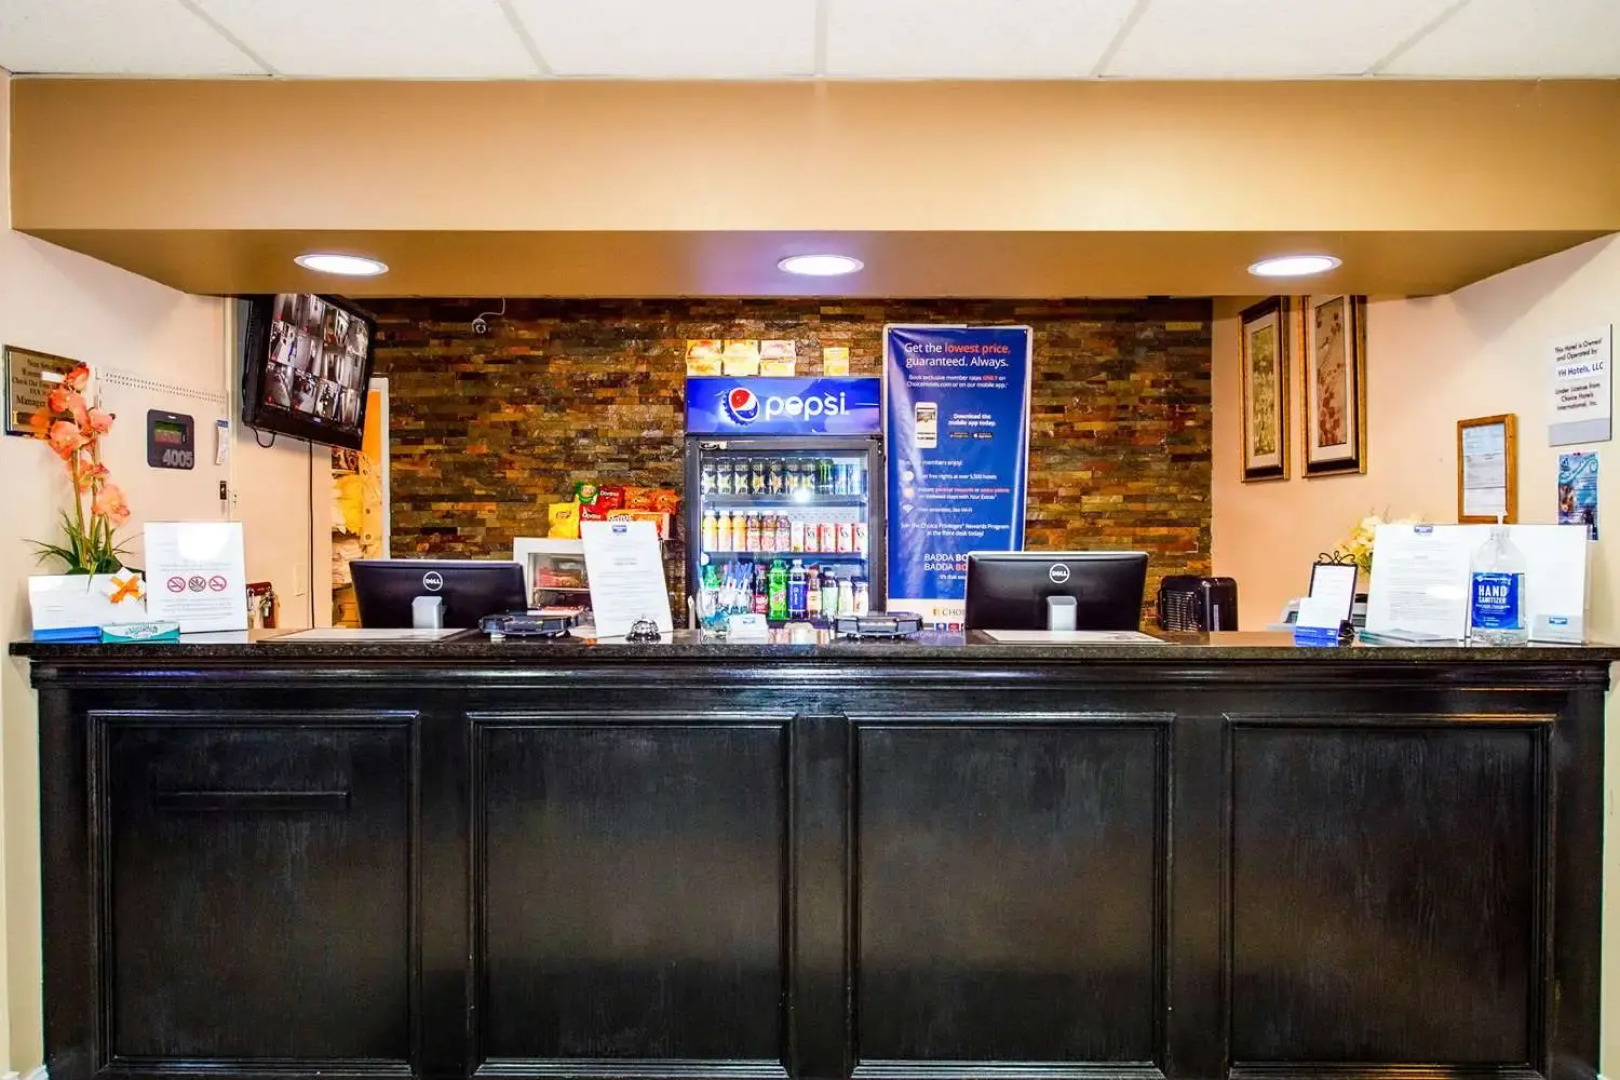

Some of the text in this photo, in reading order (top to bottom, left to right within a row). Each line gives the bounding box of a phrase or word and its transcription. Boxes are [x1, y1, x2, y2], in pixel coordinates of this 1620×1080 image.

[905, 342, 922, 353] Get
[925, 342, 942, 353] the
[945, 342, 979, 353] lowest
[906, 356, 1009, 369] guaranteed. Always.
[1592, 361, 1604, 371] LLC
[766, 391, 846, 421] pepsi
[163, 449, 193, 467] 4005
[924, 553, 954, 561] BADDA
[924, 563, 954, 571] BADDA
[1478, 585, 1507, 597] HAND
